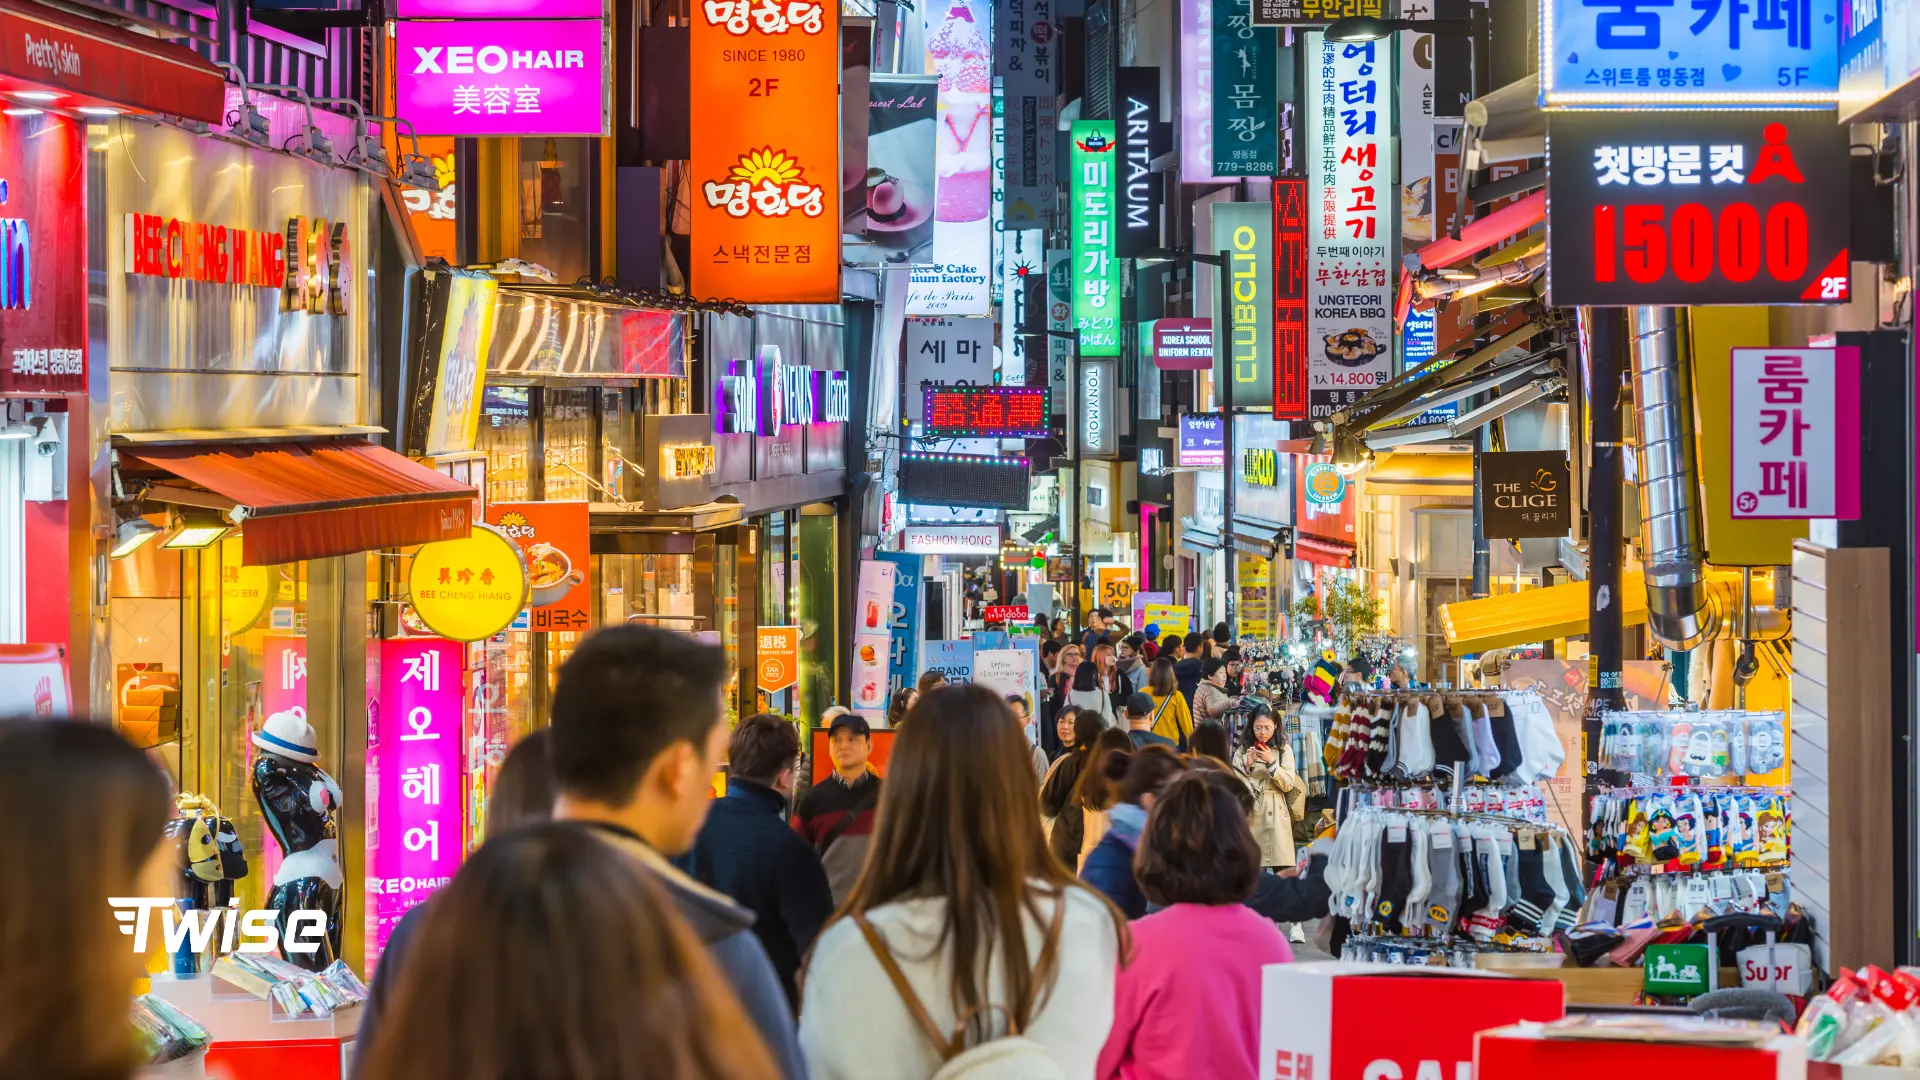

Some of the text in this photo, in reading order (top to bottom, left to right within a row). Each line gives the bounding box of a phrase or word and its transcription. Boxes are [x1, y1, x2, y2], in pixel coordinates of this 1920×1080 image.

[704, 1, 824, 36] 명화당
[61, 42, 80, 76] skin
[413, 45, 584, 74] XEO HAIR
[722, 50, 805, 62] SINCE 1980
[1585, 68, 1706, 87] 스위트룸 명동점
[1776, 67, 1810, 87] 5F
[749, 78, 779, 97] 2F
[452, 84, 542, 115] 美容室
[1339, 40, 1377, 239] 엉터리 생고기
[1127, 97, 1149, 228] ARITAUM
[1232, 149, 1258, 159] 명동점
[1217, 162, 1274, 172] 779-8286
[1593, 145, 1745, 186] 첫방문 컷
[704, 180, 824, 217] 명화당
[1083, 161, 1109, 308] 미도리가방
[1593, 202, 1809, 284] 15000
[133, 213, 285, 289] BEE CHENG HIANG
[712, 245, 811, 264] 스낵전문점
[1316, 246, 1386, 258] 두번째 이야기
[946, 263, 978, 274] Cake
[1315, 266, 1387, 287] 무한삼겹
[941, 273, 987, 285] factory
[1820, 276, 1847, 298] 2F
[941, 289, 975, 301] Paris
[1318, 295, 1382, 306] UNGTEORI
[1314, 308, 1386, 319] KOREA BBQ
[1078, 317, 1114, 331] みどり
[1080, 333, 1116, 347] かばん
[1162, 336, 1211, 346] KOREA SCHOOL
[1159, 347, 1189, 357] UNIFORM
[1329, 370, 1388, 387] 14,800원
[782, 364, 814, 425] VENUS
[1086, 368, 1099, 448] TONYMOLY
[1757, 355, 1811, 510] 룸카페
[1493, 483, 1521, 492] THE
[1494, 495, 1557, 508] CLIGE
[1738, 496, 1756, 511] 5F
[911, 535, 993, 546] FASHION HONG
[419, 590, 512, 600] BEE CHENG HIANG
[988, 611, 1027, 619] 1+1=10000
[759, 635, 787, 649] 退税
[399, 649, 441, 862] 제오헤어
